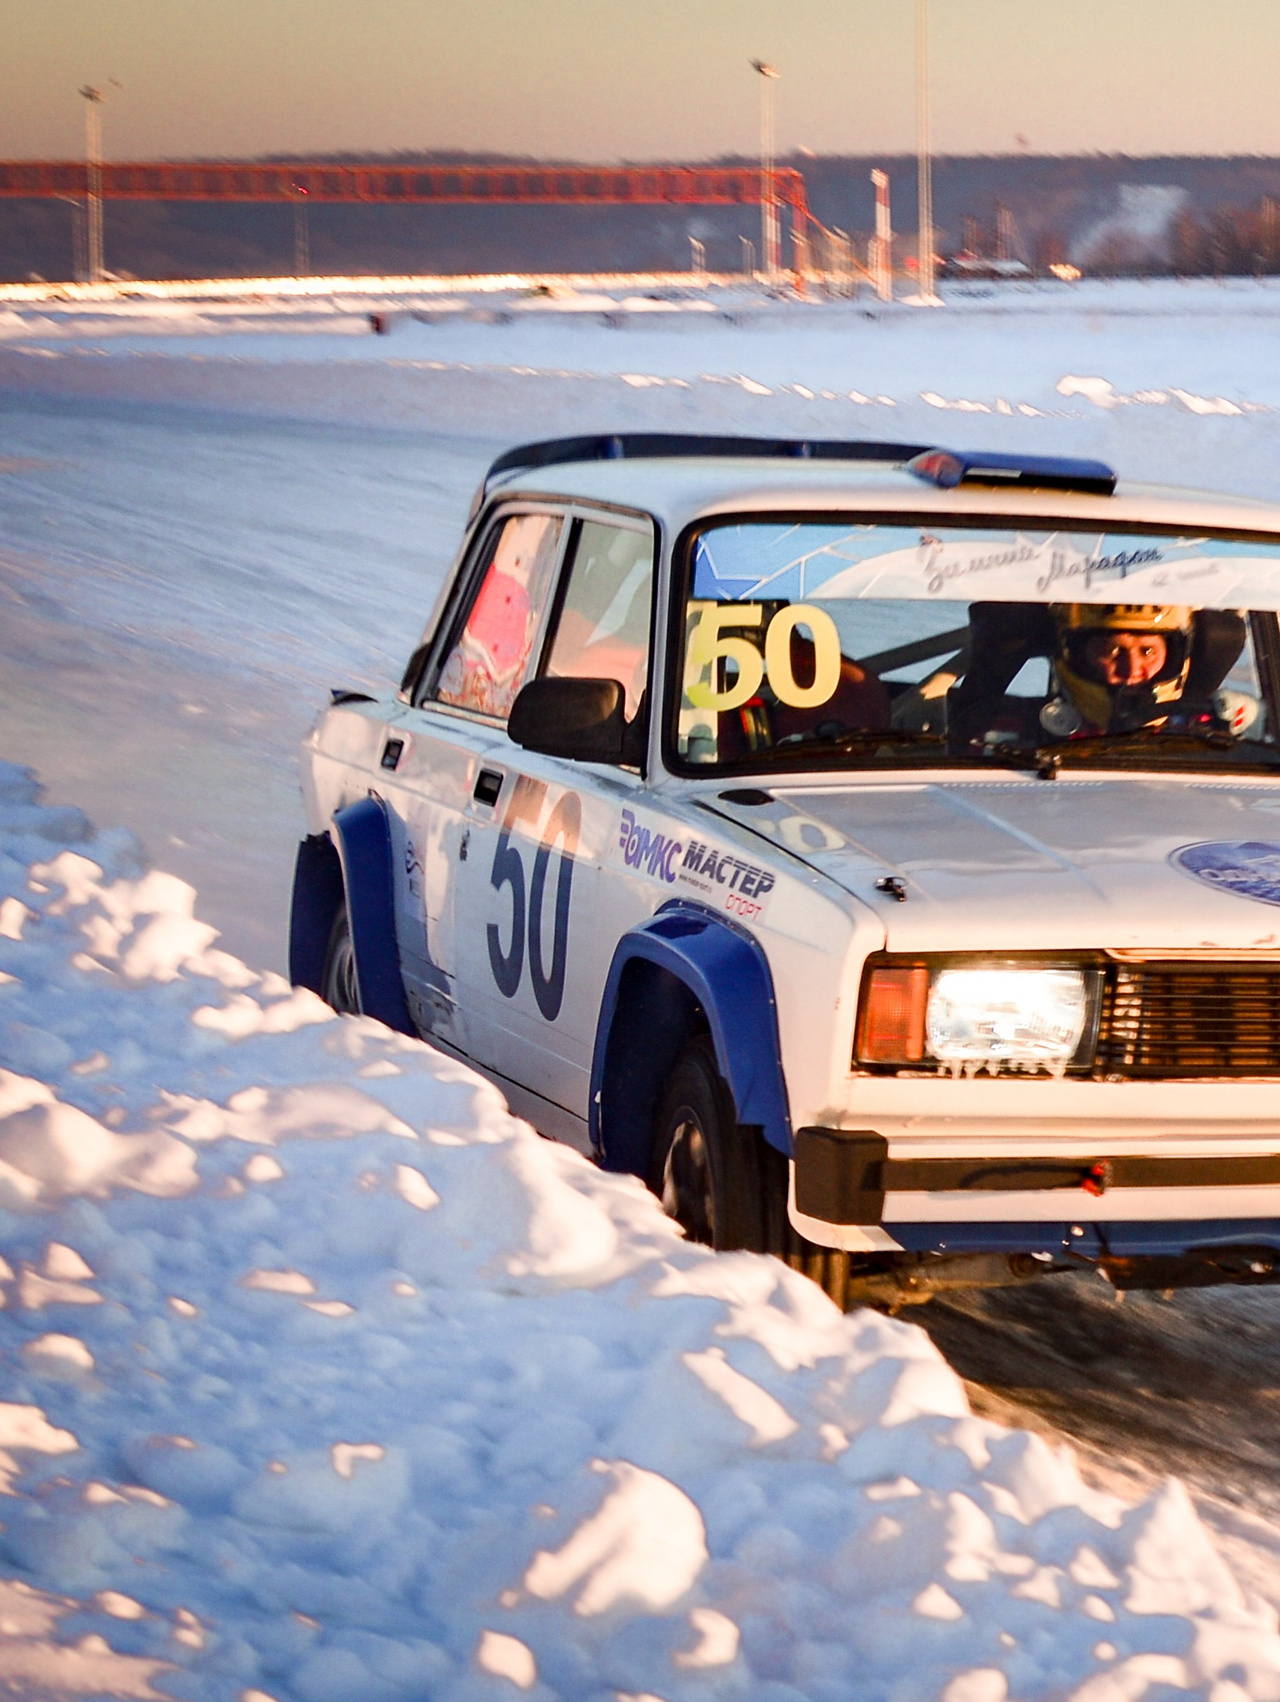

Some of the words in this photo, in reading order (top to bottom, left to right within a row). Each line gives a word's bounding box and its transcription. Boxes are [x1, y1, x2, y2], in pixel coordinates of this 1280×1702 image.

[686, 603, 842, 713] 50
[486, 773, 582, 1022] 50
[681, 840, 776, 899] МАСТЕР
[725, 893, 763, 921] СПОРТ
